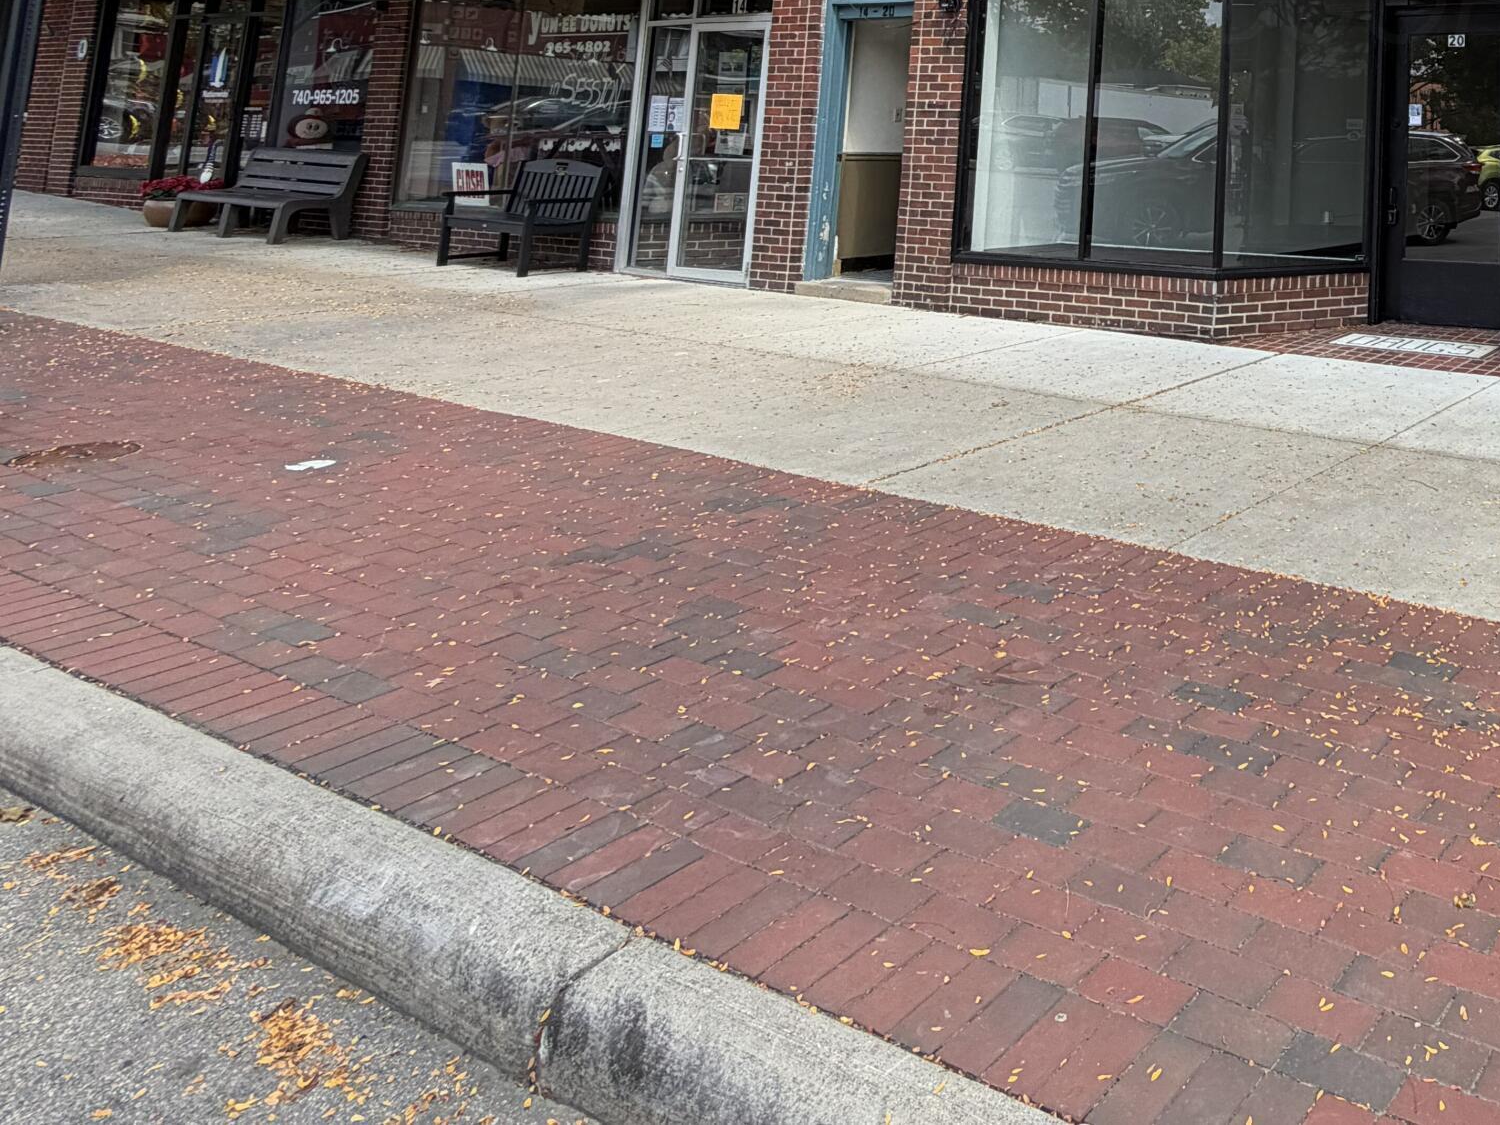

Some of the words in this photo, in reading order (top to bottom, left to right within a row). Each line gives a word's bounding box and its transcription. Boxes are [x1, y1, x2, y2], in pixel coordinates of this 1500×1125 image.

[859, 6, 869, 18] 14
[882, 5, 895, 17] 20
[1449, 35, 1464, 46] 20
[292, 88, 360, 106] 740-965-1205
[1346, 335, 1481, 355] DRUGS
